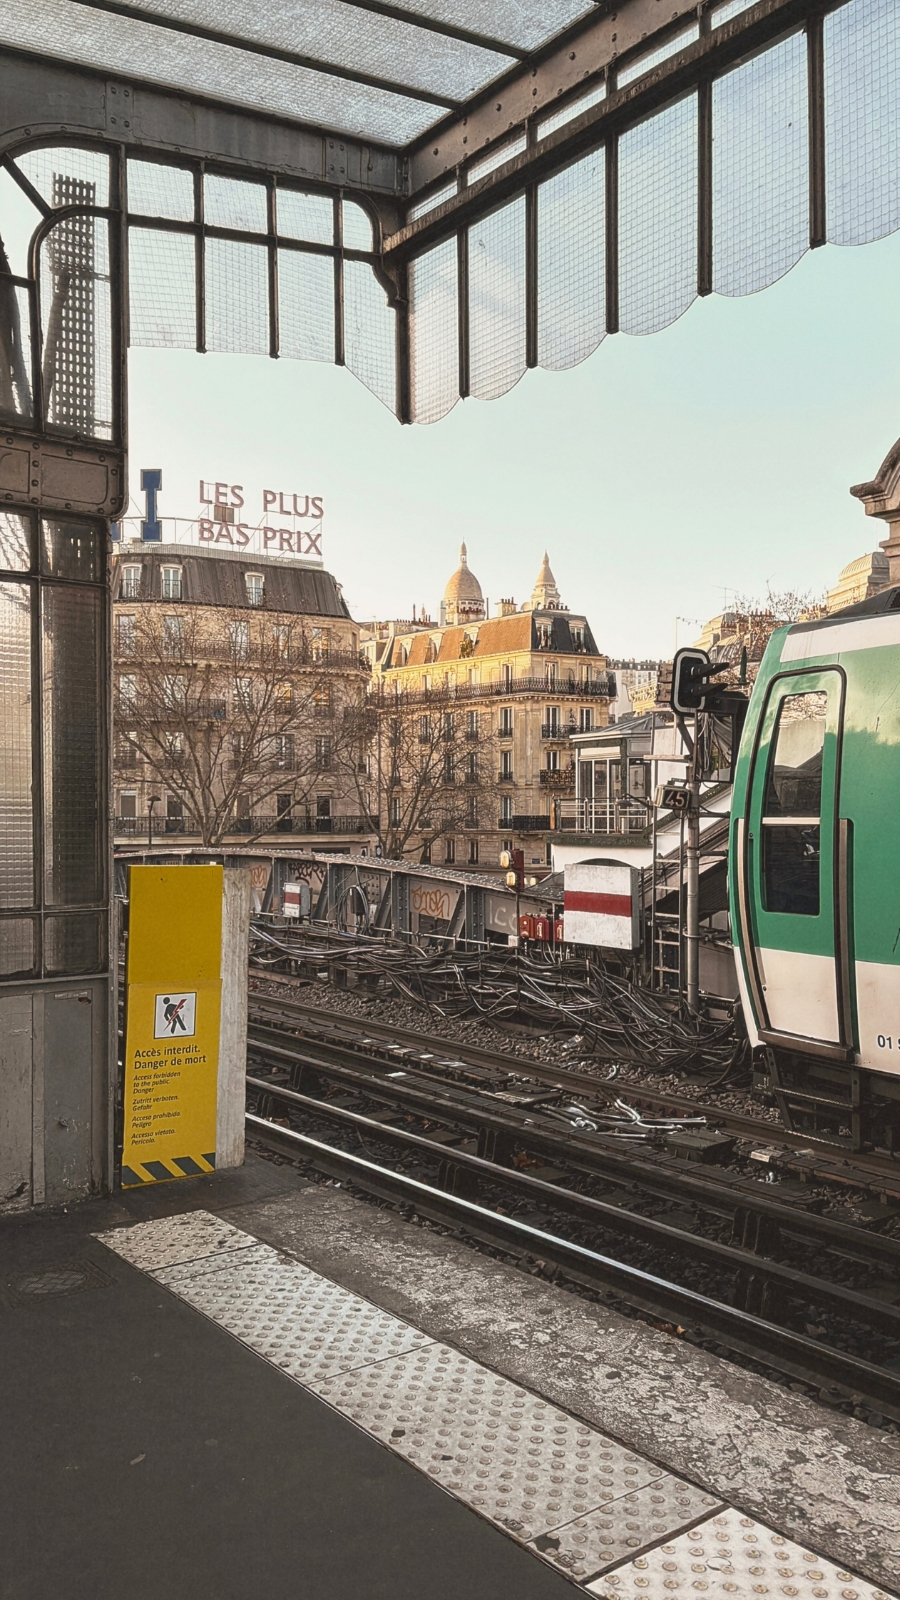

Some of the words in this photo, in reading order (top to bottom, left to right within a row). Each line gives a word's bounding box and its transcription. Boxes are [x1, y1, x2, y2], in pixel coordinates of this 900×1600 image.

[199, 480, 244, 508] LES
[263, 490, 324, 519] PLUS
[199, 518, 250, 546] BAS
[263, 526, 322, 556] PRIX
[665, 791, 685, 807] 45
[877, 1035, 892, 1050] 01
[134, 1048, 161, 1058] Accès
[164, 1044, 200, 1055] interdit.
[134, 1060, 168, 1070] Danger
[171, 1057, 182, 1066] de
[184, 1055, 206, 1064] mort
[153, 1071, 181, 1079] forbidden
[133, 1087, 155, 1095] Danger
[153, 1095, 179, 1103] verboten.
[132, 1104, 153, 1112] Gefahr
[153, 1111, 181, 1121] prohibido.
[131, 1121, 152, 1129] Peligro
[131, 1131, 154, 1139] Accesso
[155, 1128, 176, 1136] vietato.
